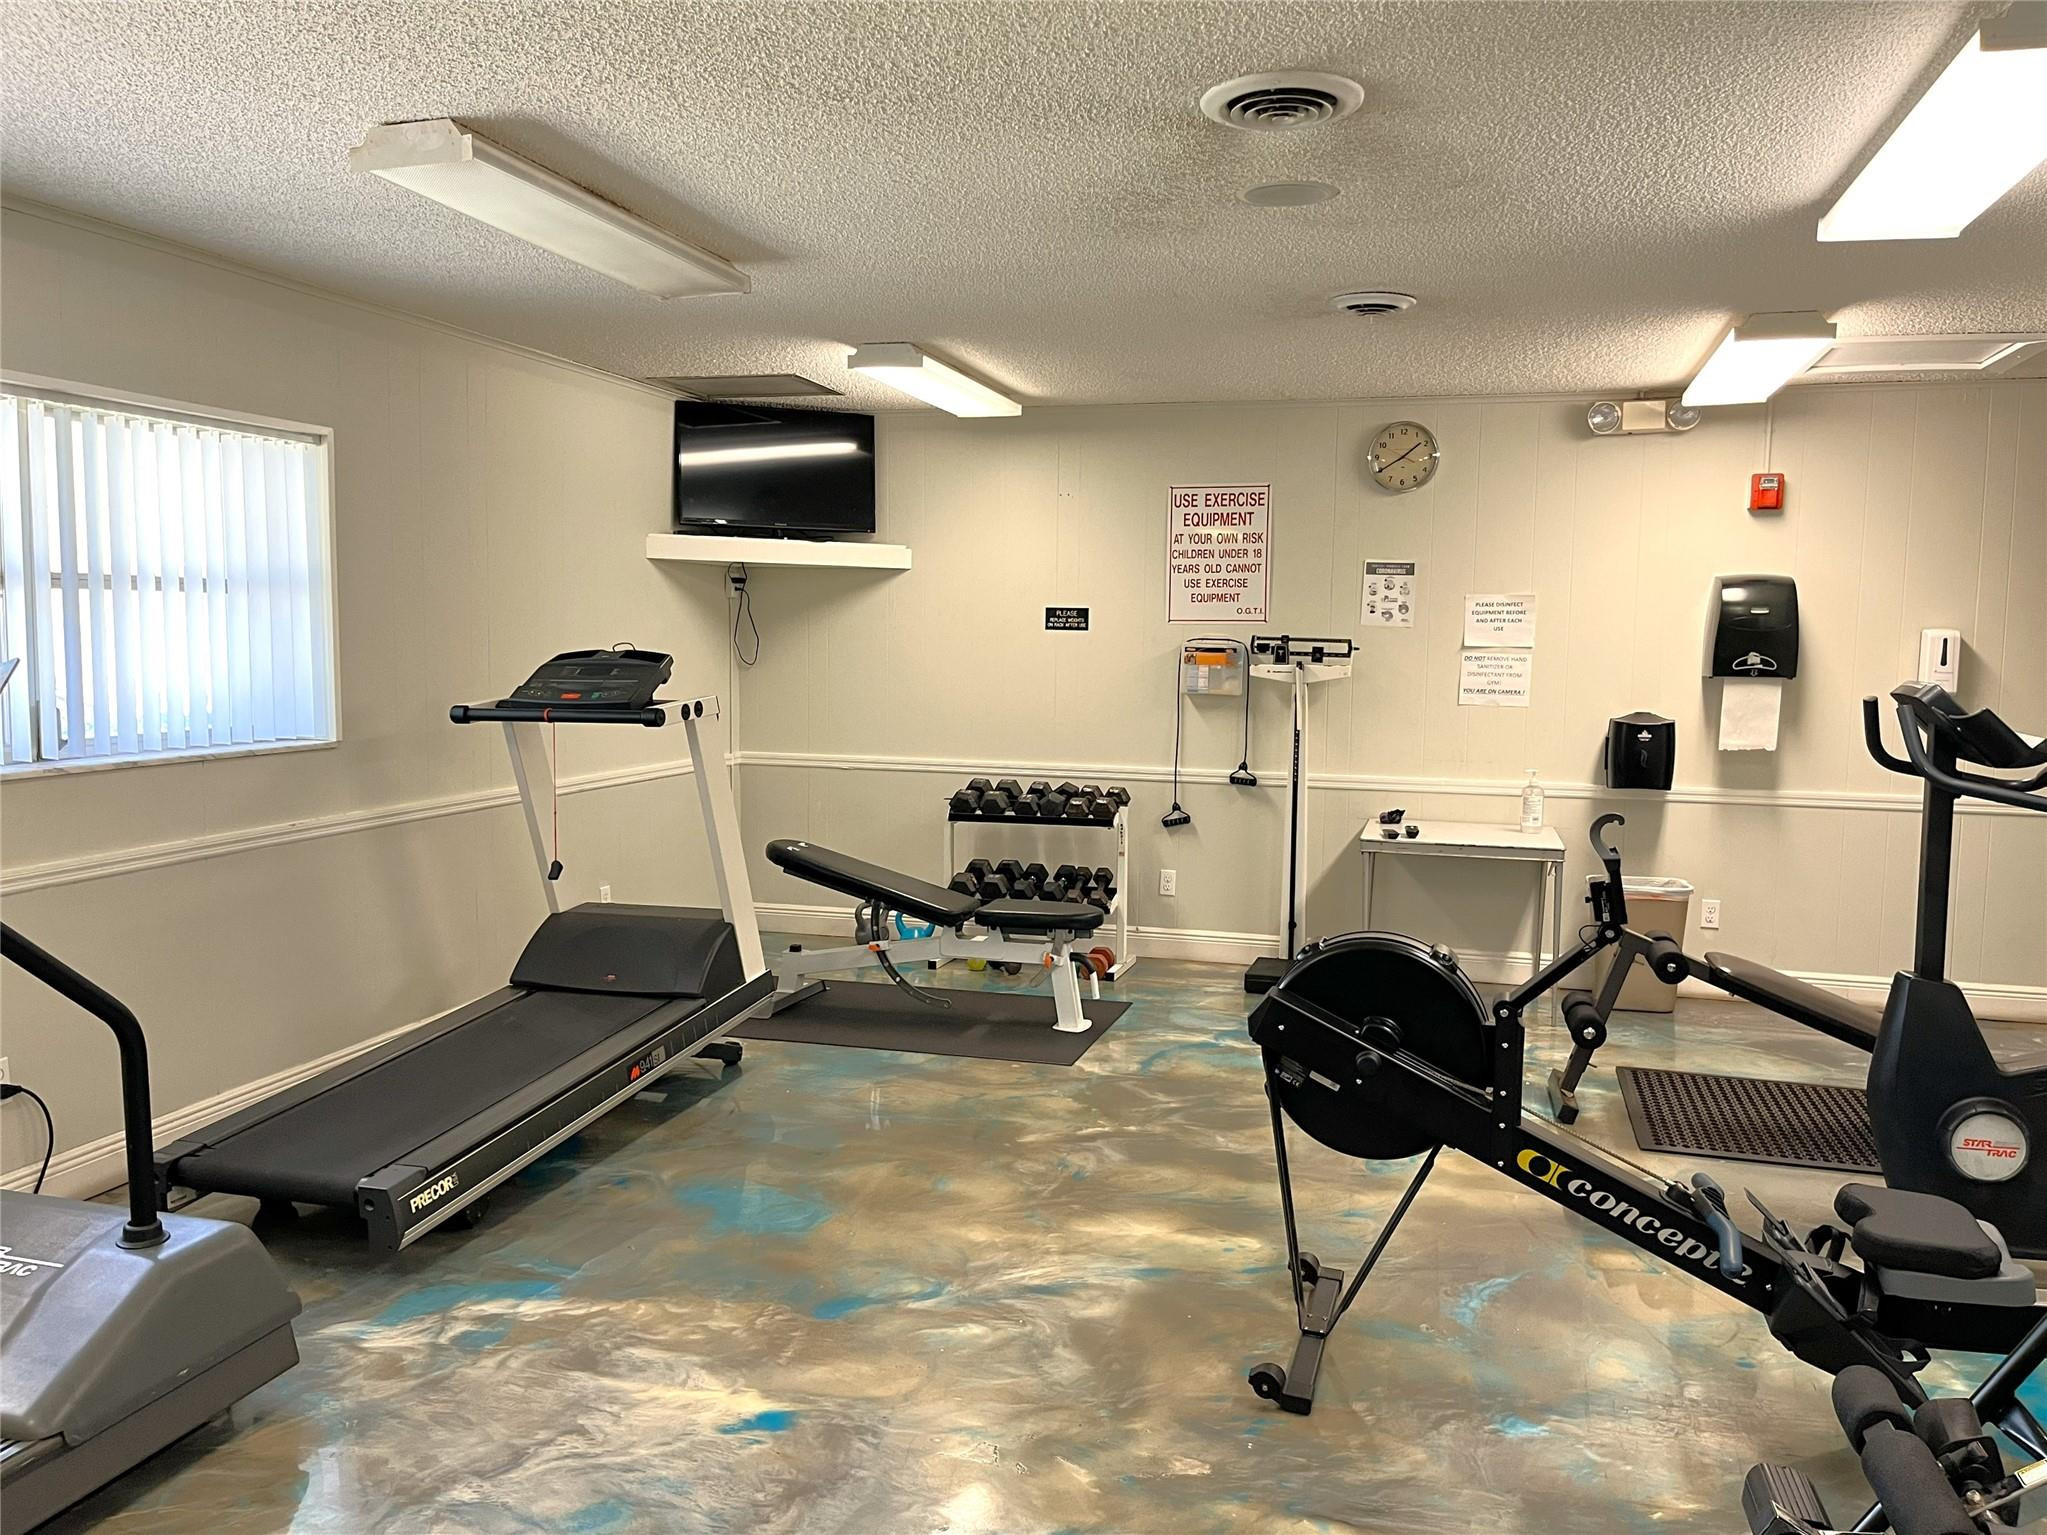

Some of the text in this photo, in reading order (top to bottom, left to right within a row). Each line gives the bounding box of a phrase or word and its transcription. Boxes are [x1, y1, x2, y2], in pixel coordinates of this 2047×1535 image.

[1174, 492, 1265, 508] USE EXERCISE
[1184, 512, 1254, 527] EQUIPMENT
[1174, 532, 1263, 544] AT YOUR OWN RISK
[1172, 549, 1262, 559] CHILDREN UNDER 18
[1172, 564, 1261, 573] YEARS OLD CANNOT
[1184, 578, 1248, 588] USE EXERCISE
[1191, 593, 1240, 602] EQUIPMENT
[1963, 1138, 1992, 1148] STAR
[1987, 1149, 2017, 1158] TRAC
[410, 1176, 454, 1214] PRECOR
